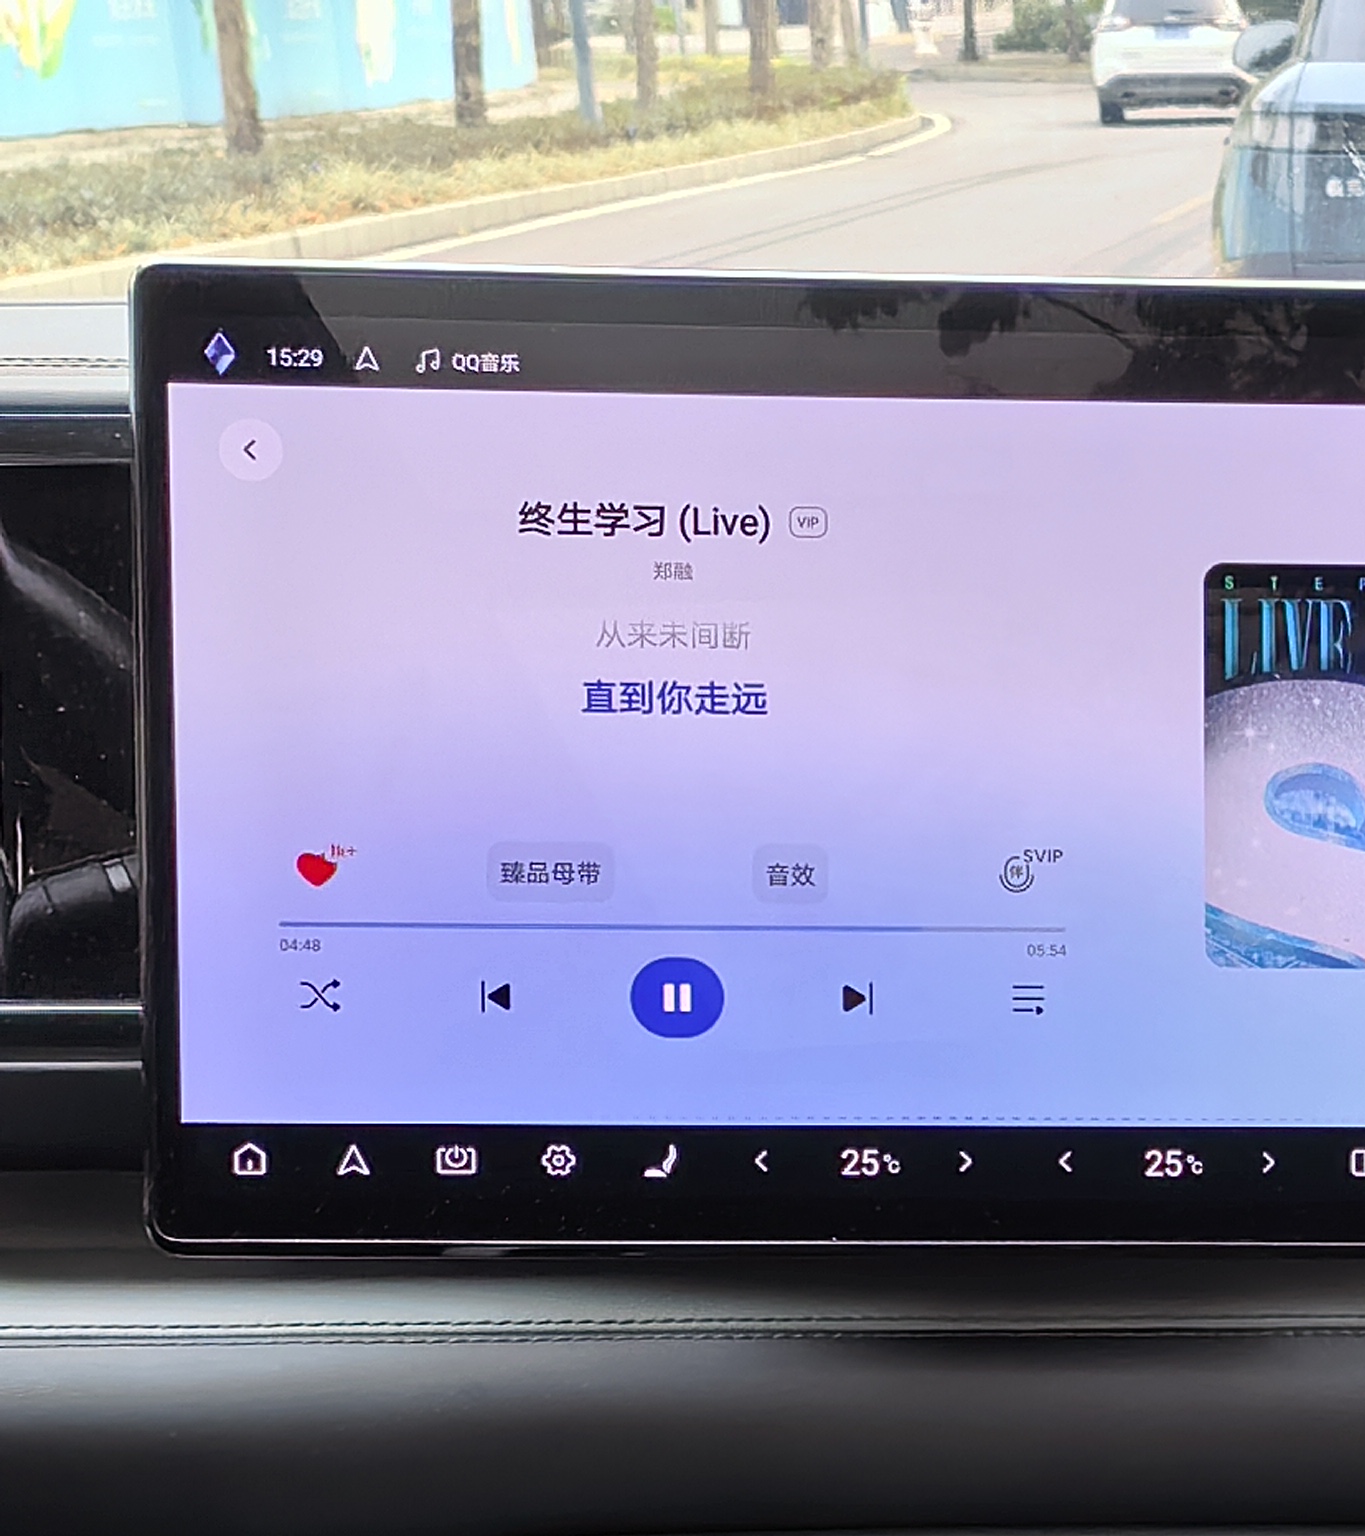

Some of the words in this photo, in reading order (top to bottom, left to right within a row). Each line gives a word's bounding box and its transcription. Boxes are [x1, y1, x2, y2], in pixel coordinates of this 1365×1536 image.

[266, 346, 324, 369] 15:29
[451, 351, 520, 374] QQ音乐
[518, 501, 666, 538] 终生学习
[679, 503, 771, 544] (Live)
[796, 515, 820, 529] VIP
[653, 561, 694, 581] 郑融
[596, 620, 752, 650] 从来未间断
[1221, 597, 1352, 681] LIVE
[581, 679, 769, 716] 直到你走远
[1023, 849, 1063, 864] SVIP
[500, 861, 601, 885] 臻品母带
[766, 862, 816, 888] 音效
[280, 939, 321, 952] 04:48
[1026, 943, 1067, 957] 05:54
